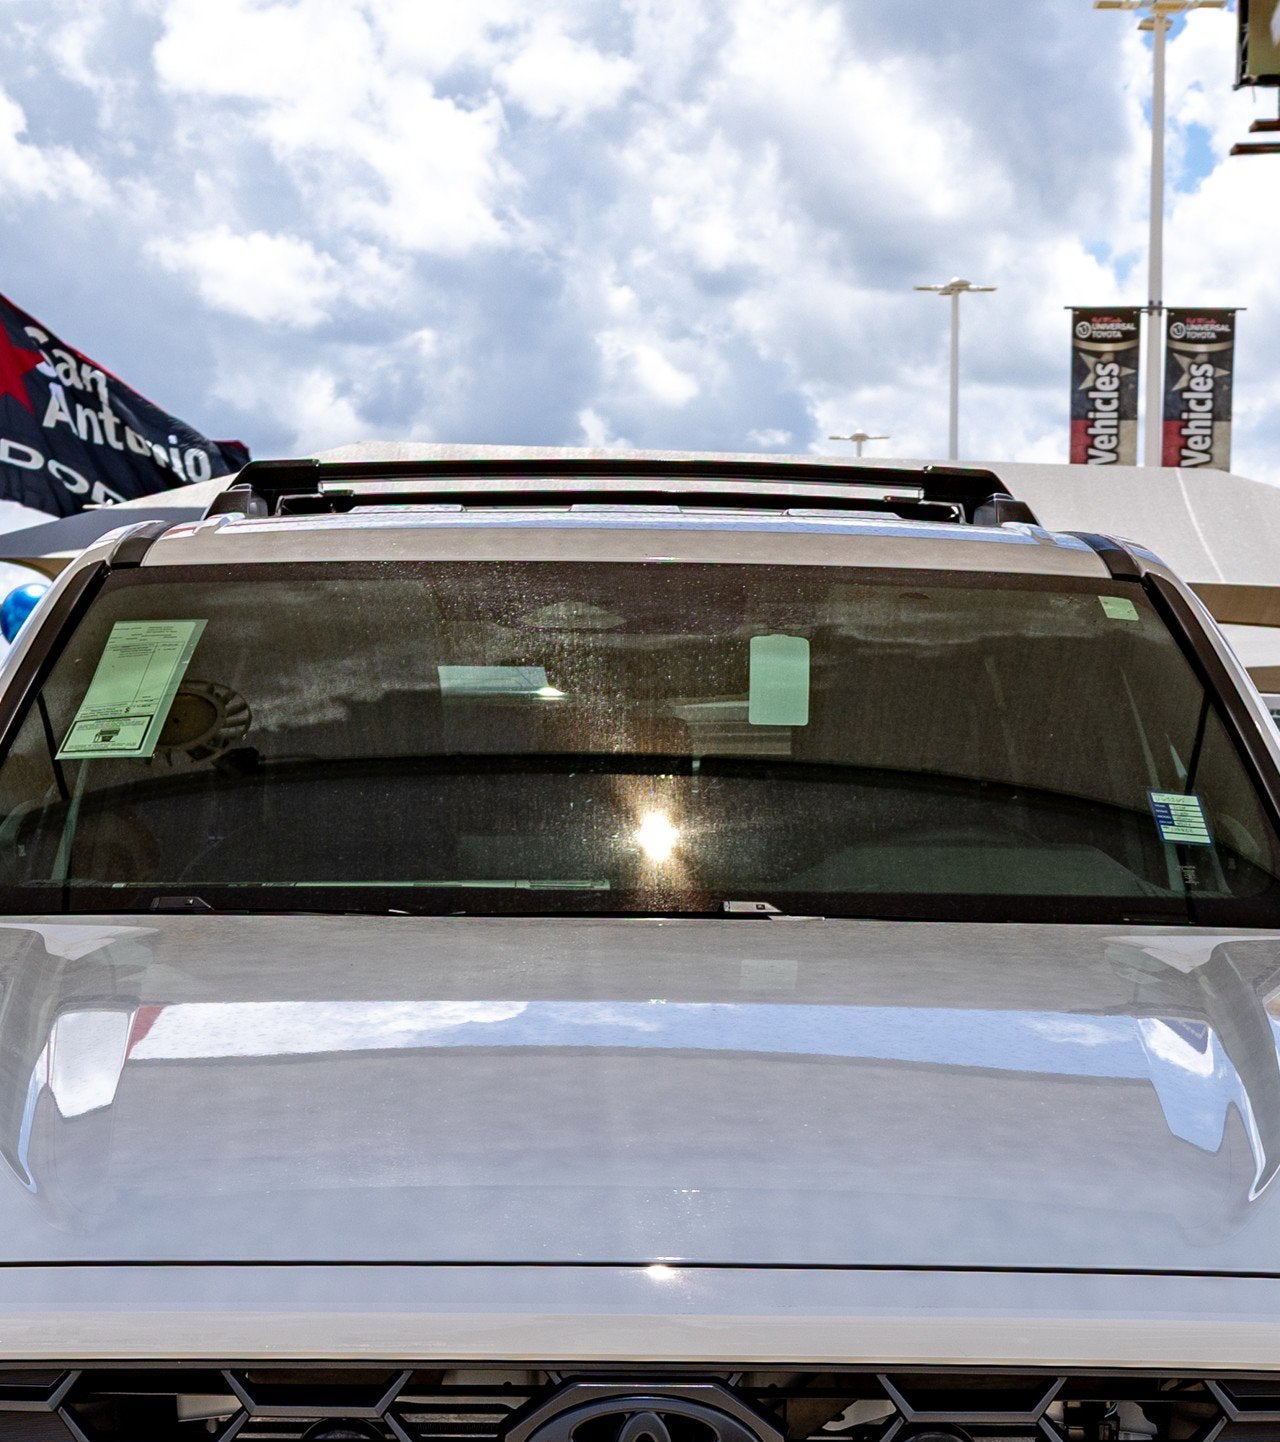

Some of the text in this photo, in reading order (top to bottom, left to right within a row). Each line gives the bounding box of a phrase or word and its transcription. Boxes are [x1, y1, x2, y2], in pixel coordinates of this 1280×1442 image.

[23, 325, 110, 404] San
[1087, 362, 1120, 465] Vehicles
[1180, 363, 1214, 467] Vehicles
[42, 382, 212, 484] Antonio
